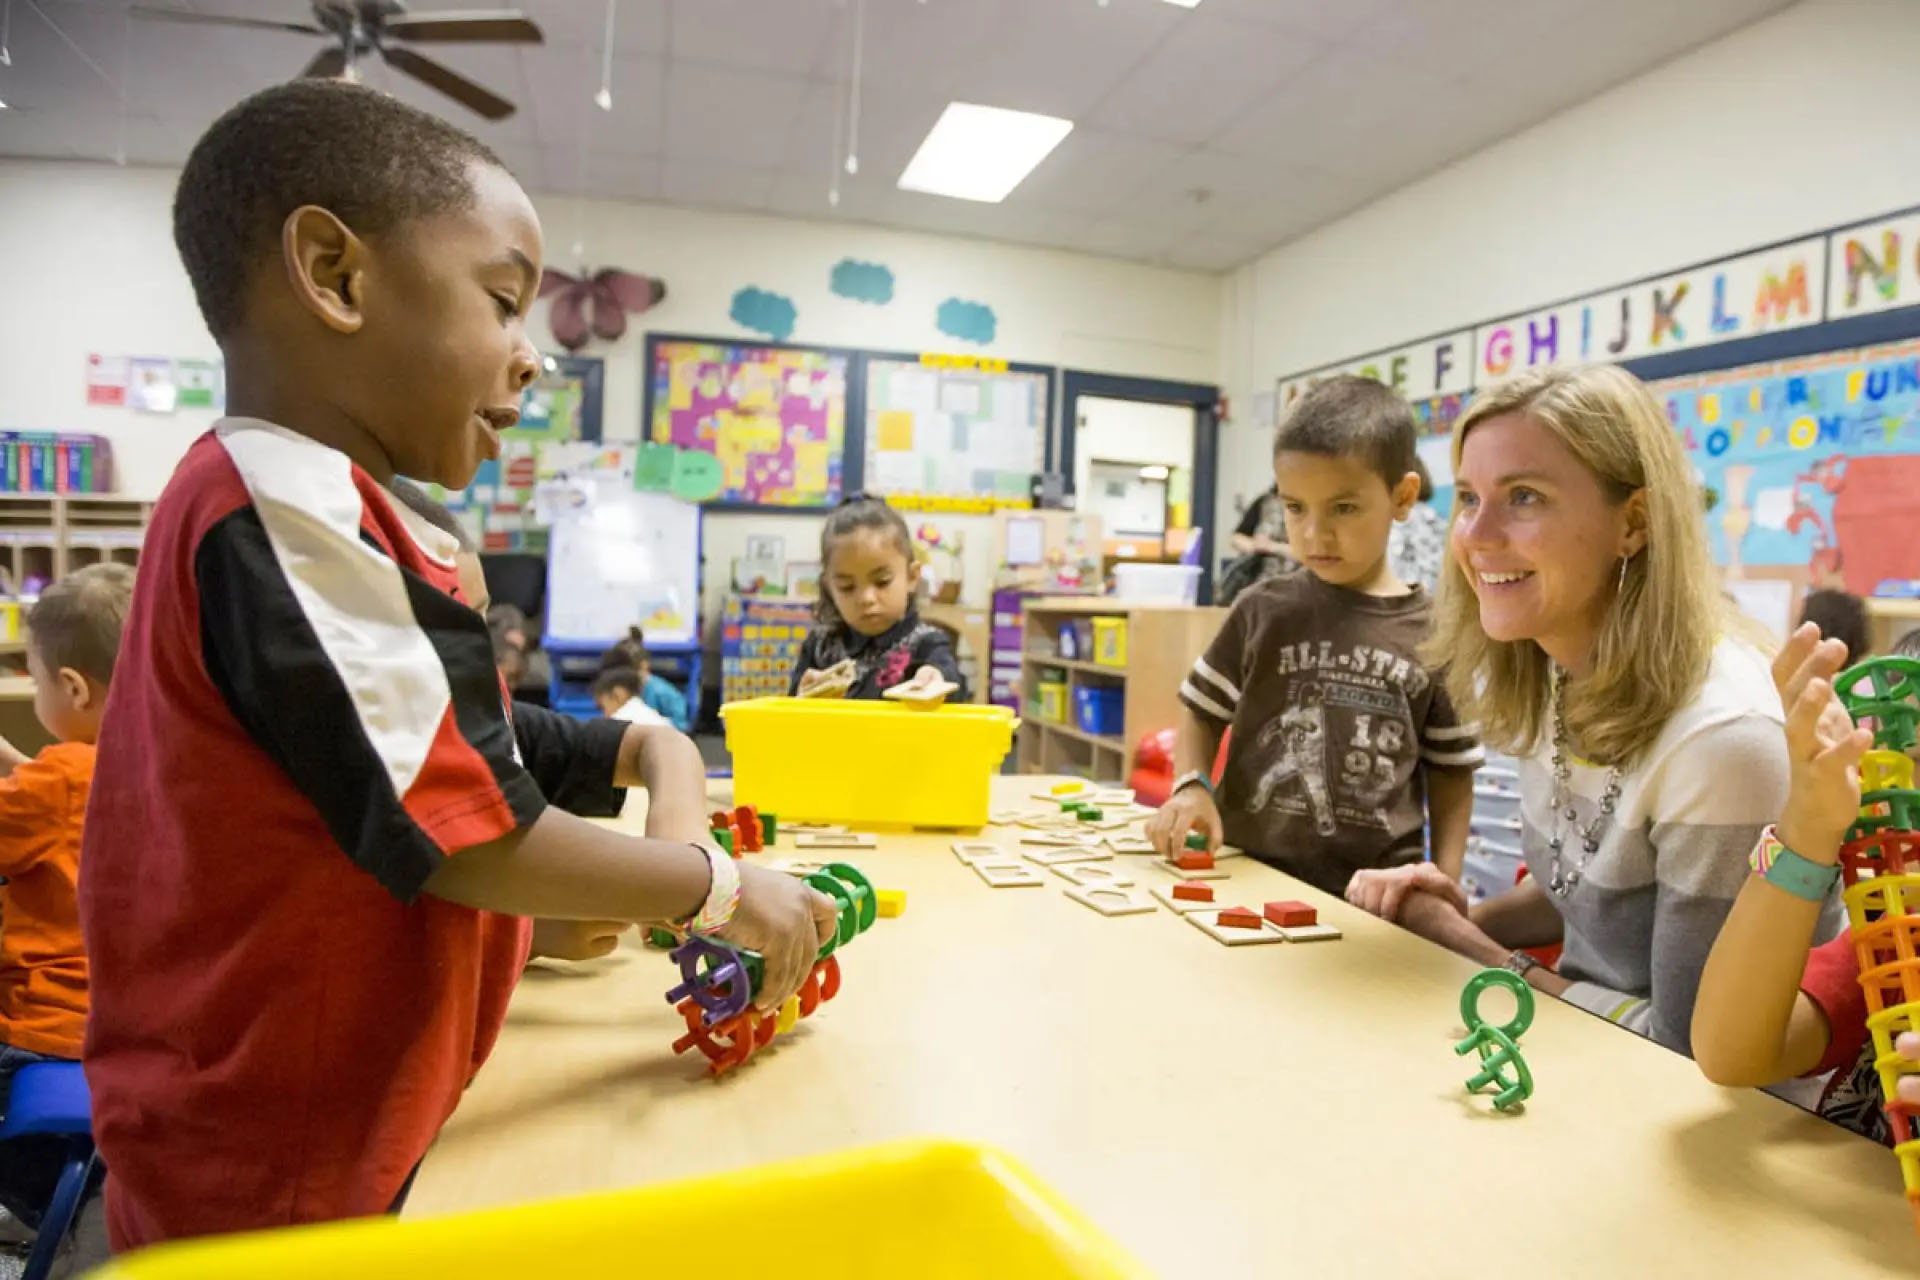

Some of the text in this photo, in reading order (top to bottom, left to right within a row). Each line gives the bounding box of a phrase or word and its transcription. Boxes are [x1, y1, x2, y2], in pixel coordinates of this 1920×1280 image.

[1434, 344, 1453, 390] F
[1484, 327, 1513, 375] G
[1527, 314, 1558, 366] H
[1580, 304, 1592, 357] I
[1606, 297, 1630, 353] J
[1651, 280, 1690, 347] K
[1711, 271, 1740, 333] L
[1754, 260, 1810, 326] M
[1844, 228, 1900, 308] N
